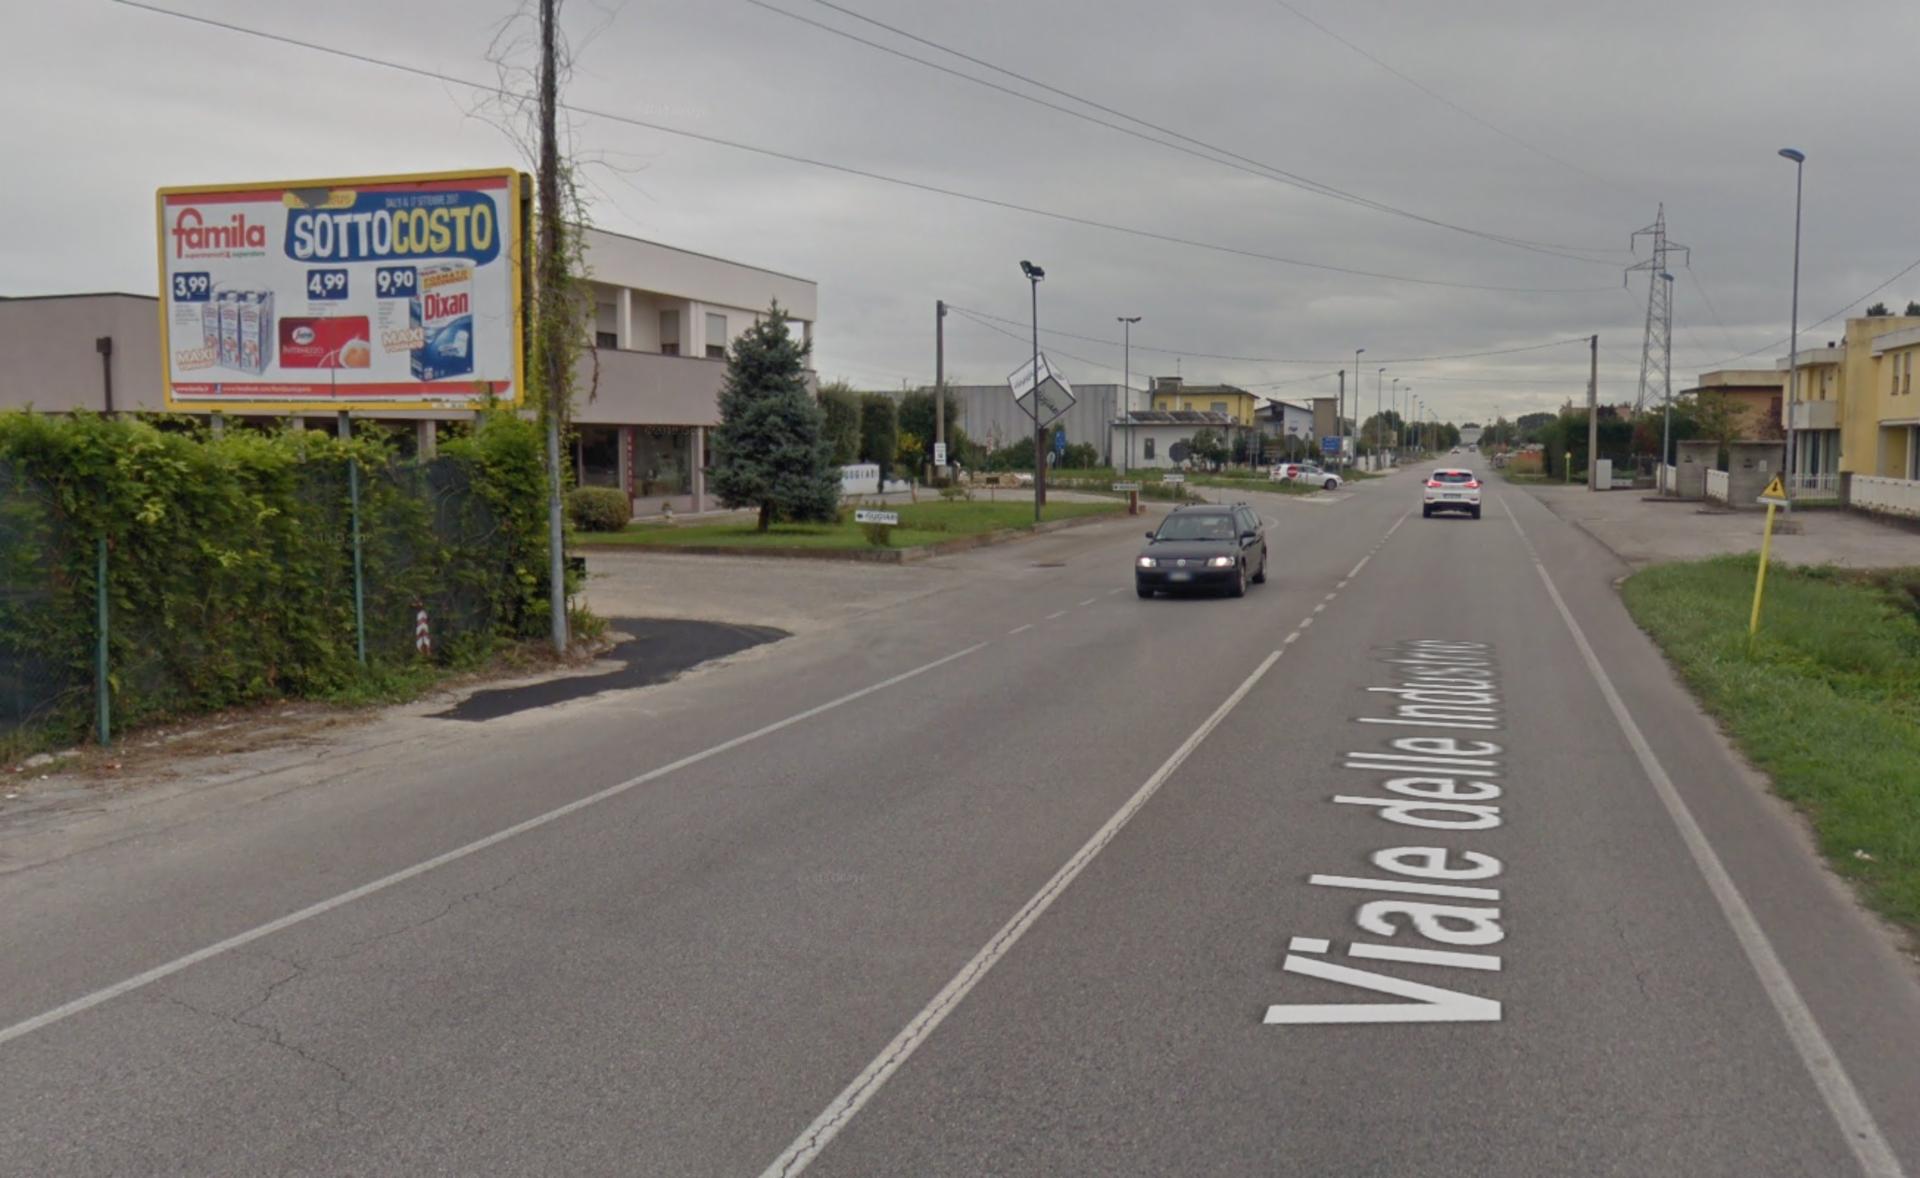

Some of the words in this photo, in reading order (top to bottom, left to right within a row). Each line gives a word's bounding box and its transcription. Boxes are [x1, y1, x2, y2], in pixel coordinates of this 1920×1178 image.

[172, 207, 266, 259] famila
[294, 203, 493, 259] SOTTOCOSTO
[175, 275, 208, 299] 3,99
[309, 273, 345, 297] 4,99
[378, 270, 414, 295] 9,90
[424, 292, 469, 321] Dixan
